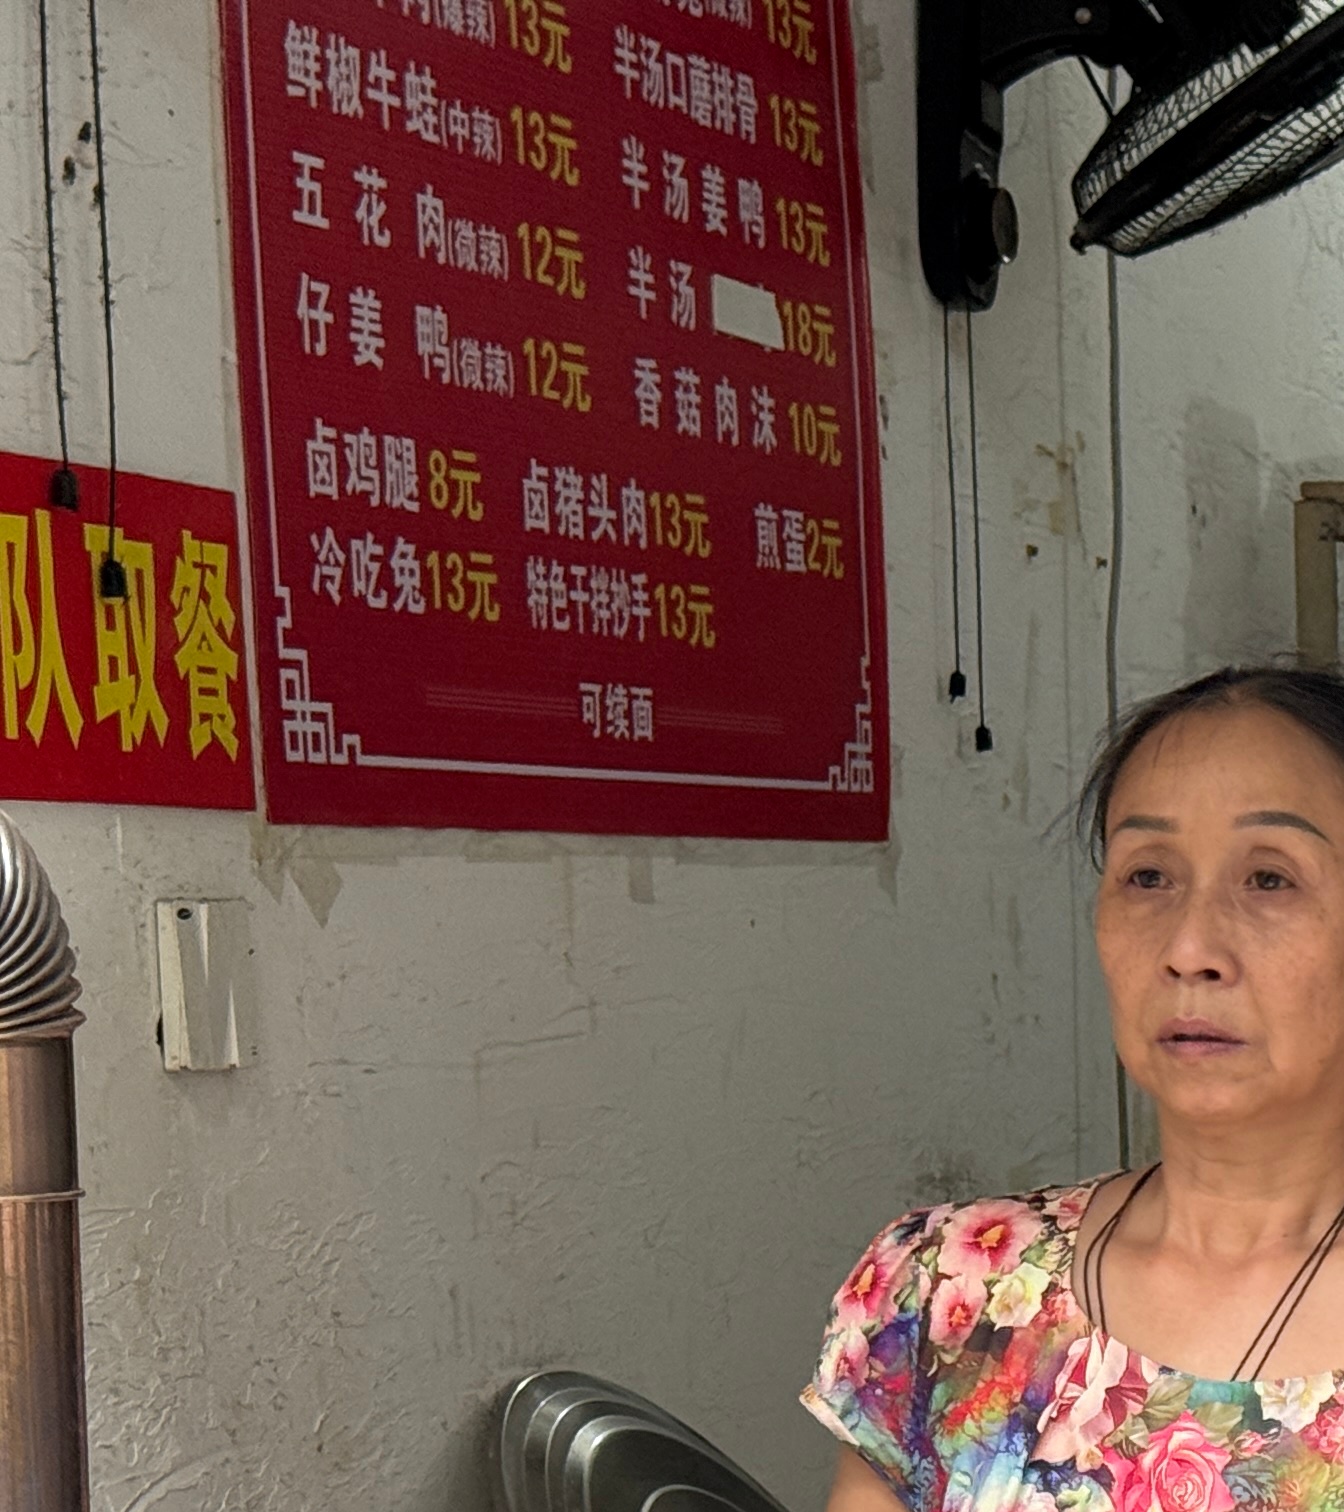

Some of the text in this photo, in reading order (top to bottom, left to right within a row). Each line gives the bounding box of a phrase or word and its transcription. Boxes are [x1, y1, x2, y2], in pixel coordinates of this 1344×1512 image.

[614, 23, 824, 167] 半汤口蘑排骨 13元
[510, 106, 580, 187] 13元
[621, 134, 831, 268] 半汤姜鸭 13元
[516, 222, 587, 300] 12元
[783, 300, 837, 368] 18元
[522, 337, 592, 413] 12元
[634, 357, 843, 467] 香菇肉沫 10元
[305, 418, 484, 522] 卤鸡腿 8元
[523, 457, 712, 559] 卤猪头肉 13元
[310, 525, 501, 625] 冷吃兔 13元
[755, 502, 845, 581] 煎蛋 2元
[654, 582, 716, 650] 13元
[579, 681, 654, 742] 可续面
